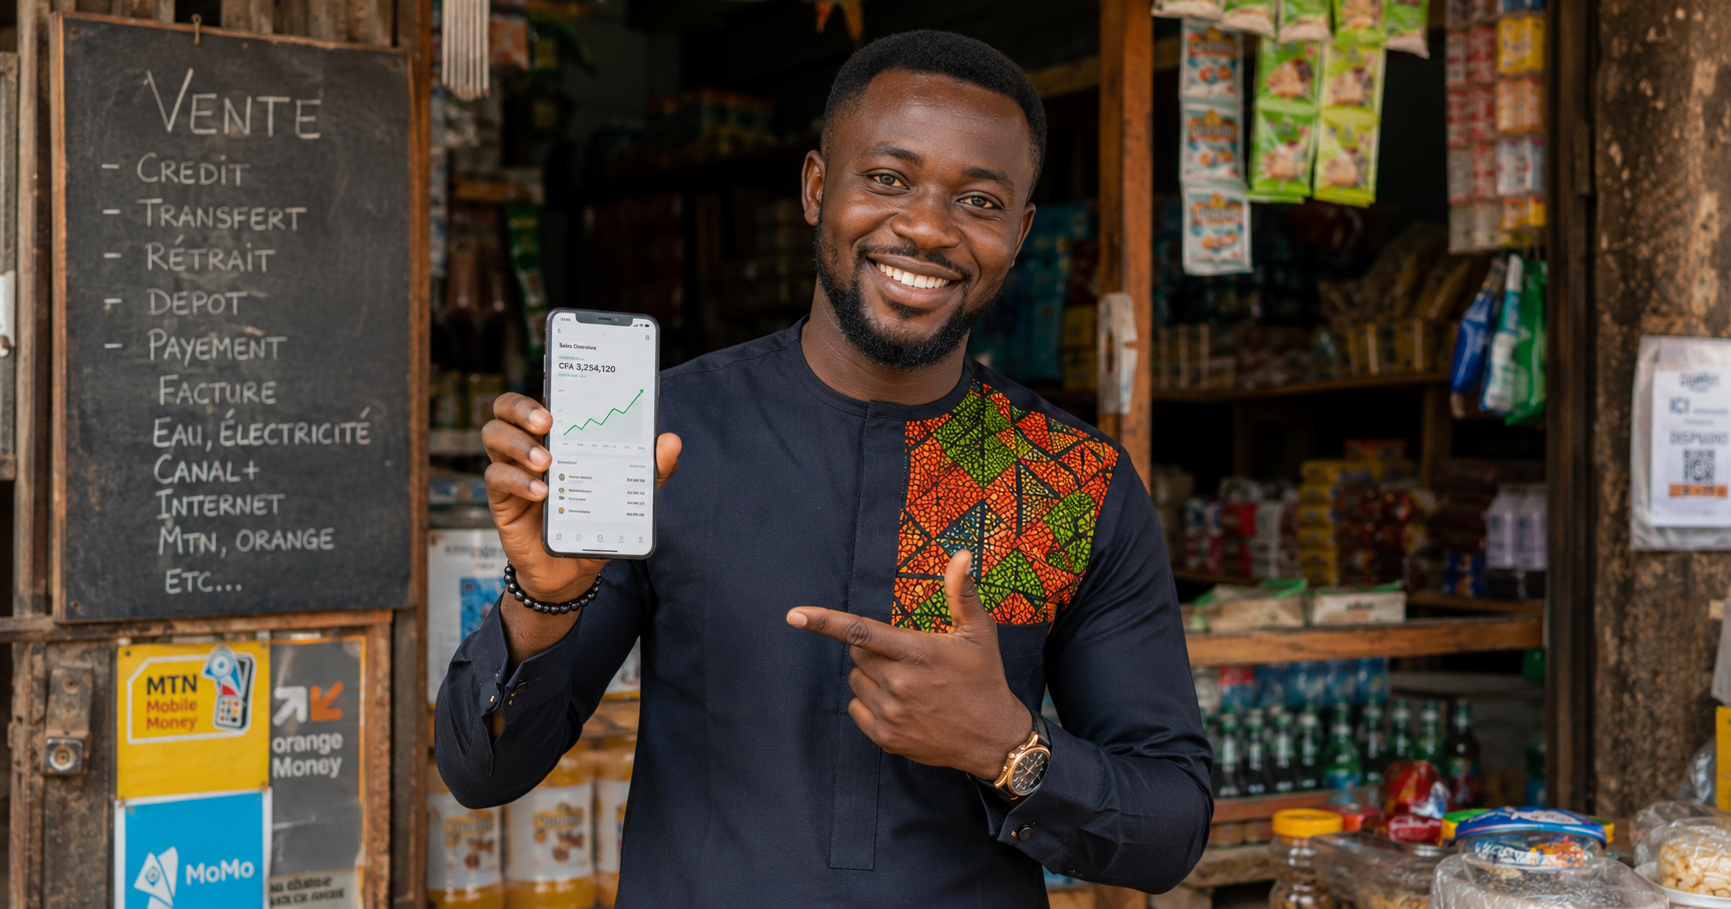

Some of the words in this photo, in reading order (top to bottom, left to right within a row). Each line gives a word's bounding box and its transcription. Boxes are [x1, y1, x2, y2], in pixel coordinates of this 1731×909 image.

[147, 67, 322, 139] VENTE
[137, 198, 308, 231] TRANSFERT
[146, 287, 249, 316] DEPOT
[147, 328, 288, 367] PAYEMENT
[558, 362, 575, 370] CFA
[576, 362, 616, 373] 3,254,120
[158, 374, 278, 405] FACTURE
[153, 453, 261, 485] CANAL+
[155, 488, 286, 521] INTERNET
[158, 525, 227, 559] MTN,
[235, 527, 336, 552] ORANGE
[146, 674, 198, 696] MTN
[146, 698, 198, 714] Mobile
[146, 715, 198, 732] Money
[272, 732, 343, 755] orange
[272, 756, 343, 778] Money
[185, 858, 255, 886] MoMo
